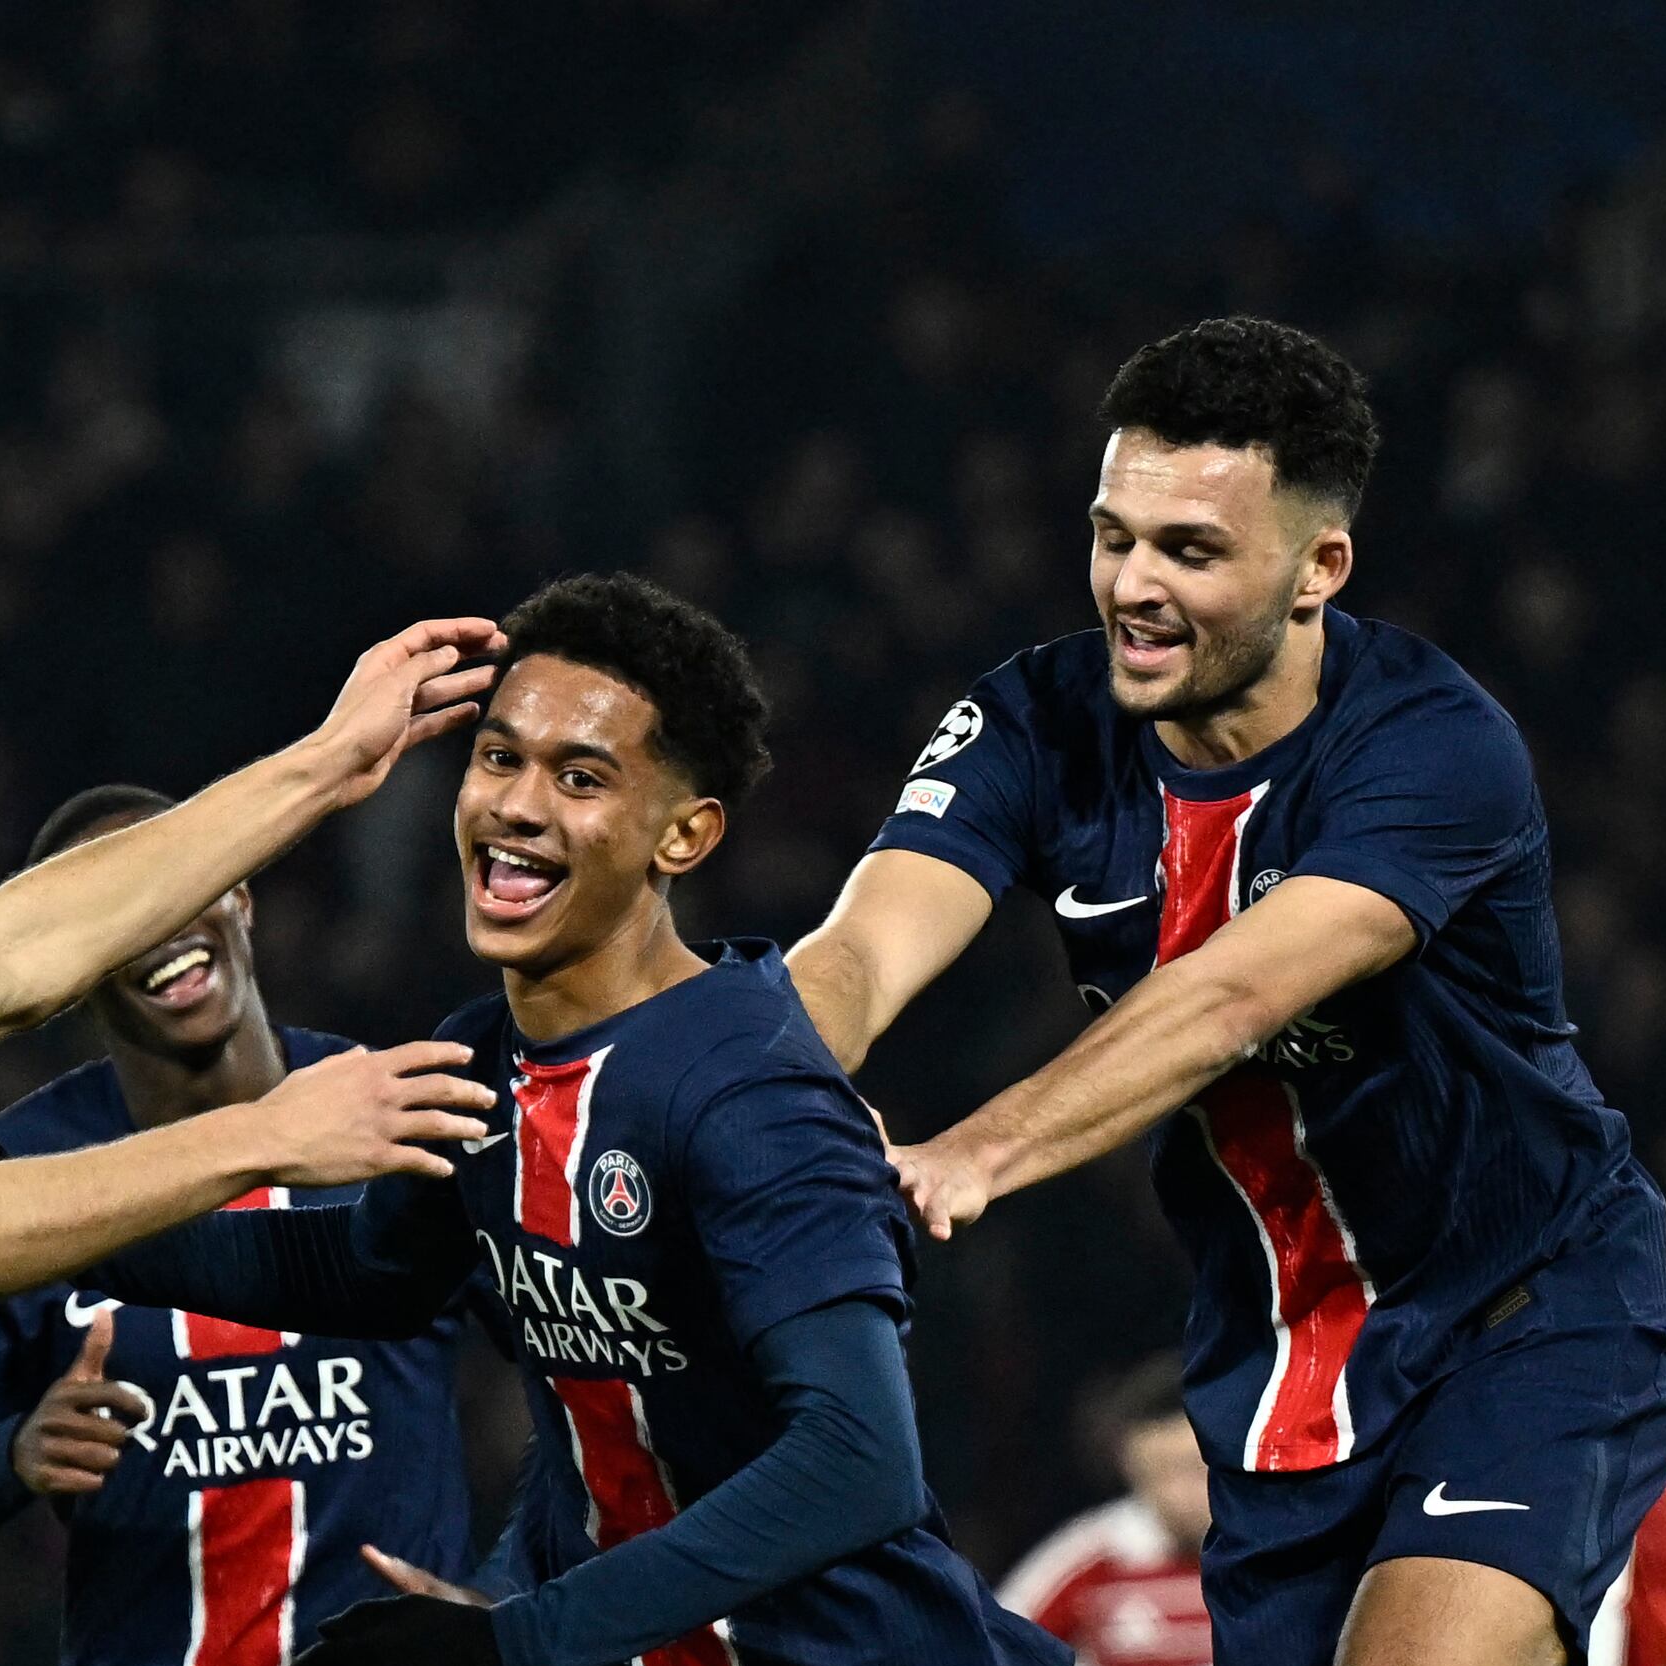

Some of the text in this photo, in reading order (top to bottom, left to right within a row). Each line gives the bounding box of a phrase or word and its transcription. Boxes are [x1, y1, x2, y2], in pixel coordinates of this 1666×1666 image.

[1255, 873, 1286, 892] PAR
[599, 1154, 638, 1178] PARIS
[163, 1419, 374, 1478] AIRWAYS
